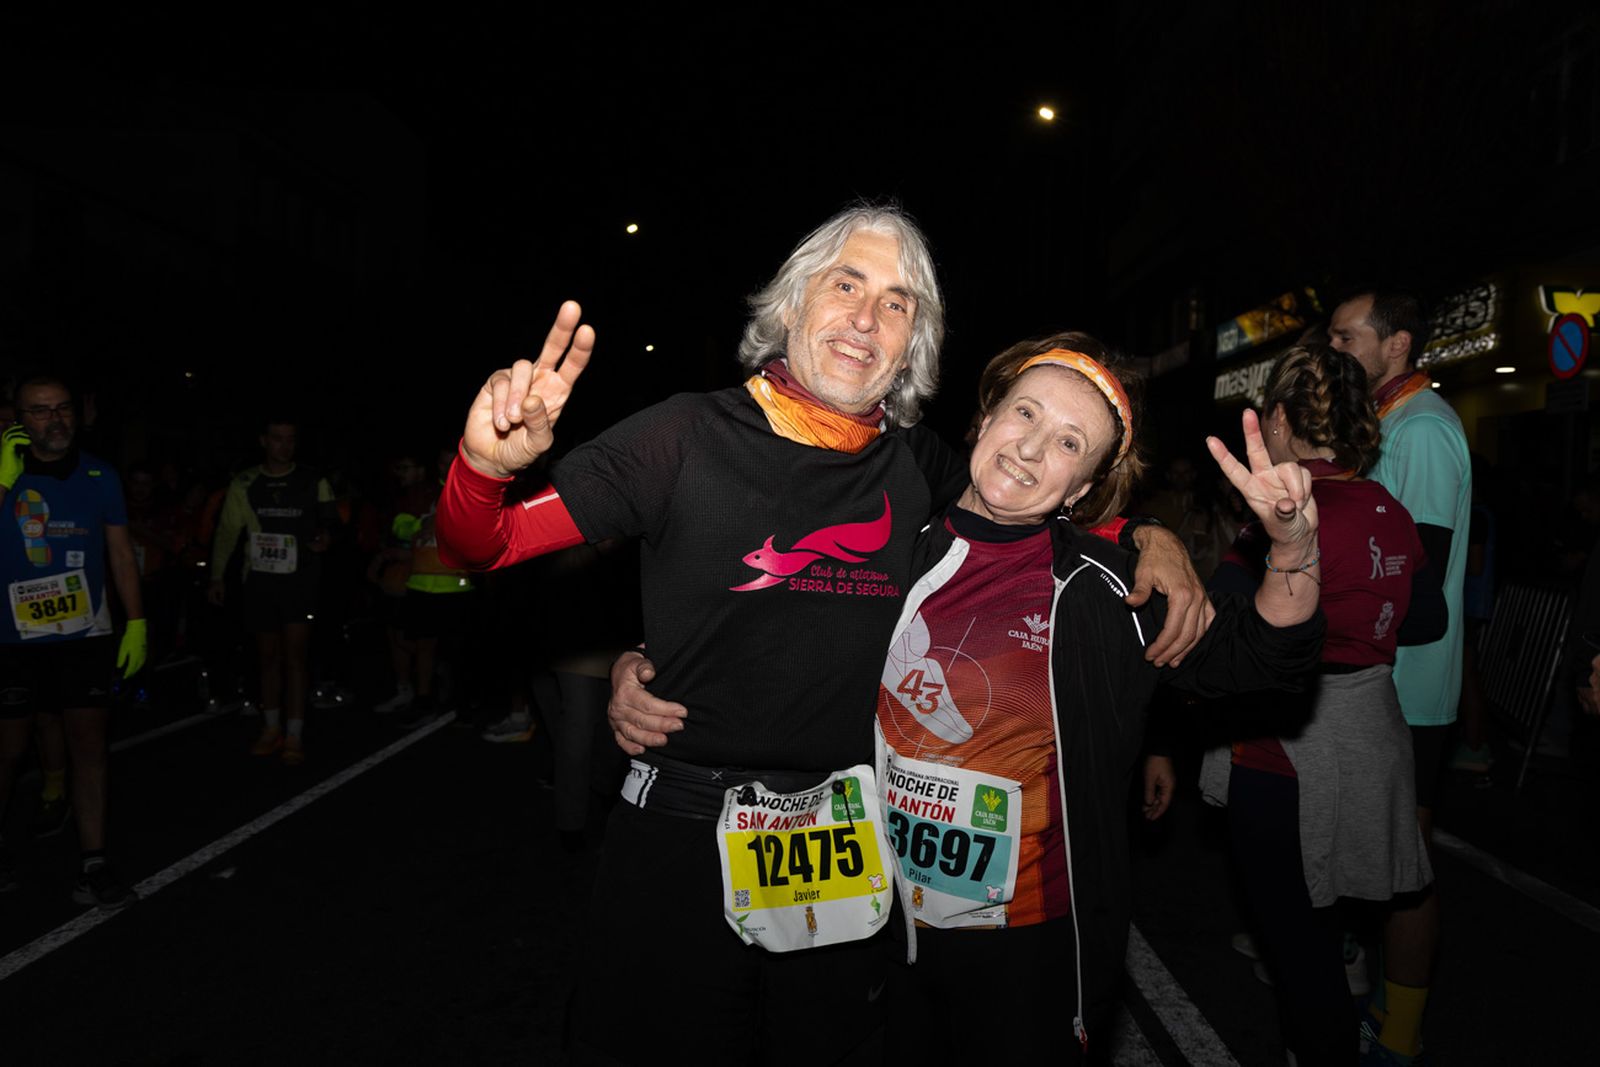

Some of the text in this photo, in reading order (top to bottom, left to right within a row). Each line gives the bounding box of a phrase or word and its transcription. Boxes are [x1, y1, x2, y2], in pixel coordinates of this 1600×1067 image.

[811, 565, 833, 578] Club
[836, 568, 847, 578] de
[788, 578, 900, 597] SIERRA DE SEGURA
[28, 594, 77, 620] 3847
[1008, 629, 1029, 640] CAJA
[896, 668, 944, 715] 43
[887, 770, 960, 802] NOCHE DE
[757, 795, 809, 812] NOCHE
[898, 795, 956, 823] ANTÓN
[737, 811, 768, 830] SAN
[888, 811, 997, 882] 3697
[747, 826, 864, 888] 12475
[909, 868, 932, 885] Pilar
[793, 889, 821, 902] Javier
